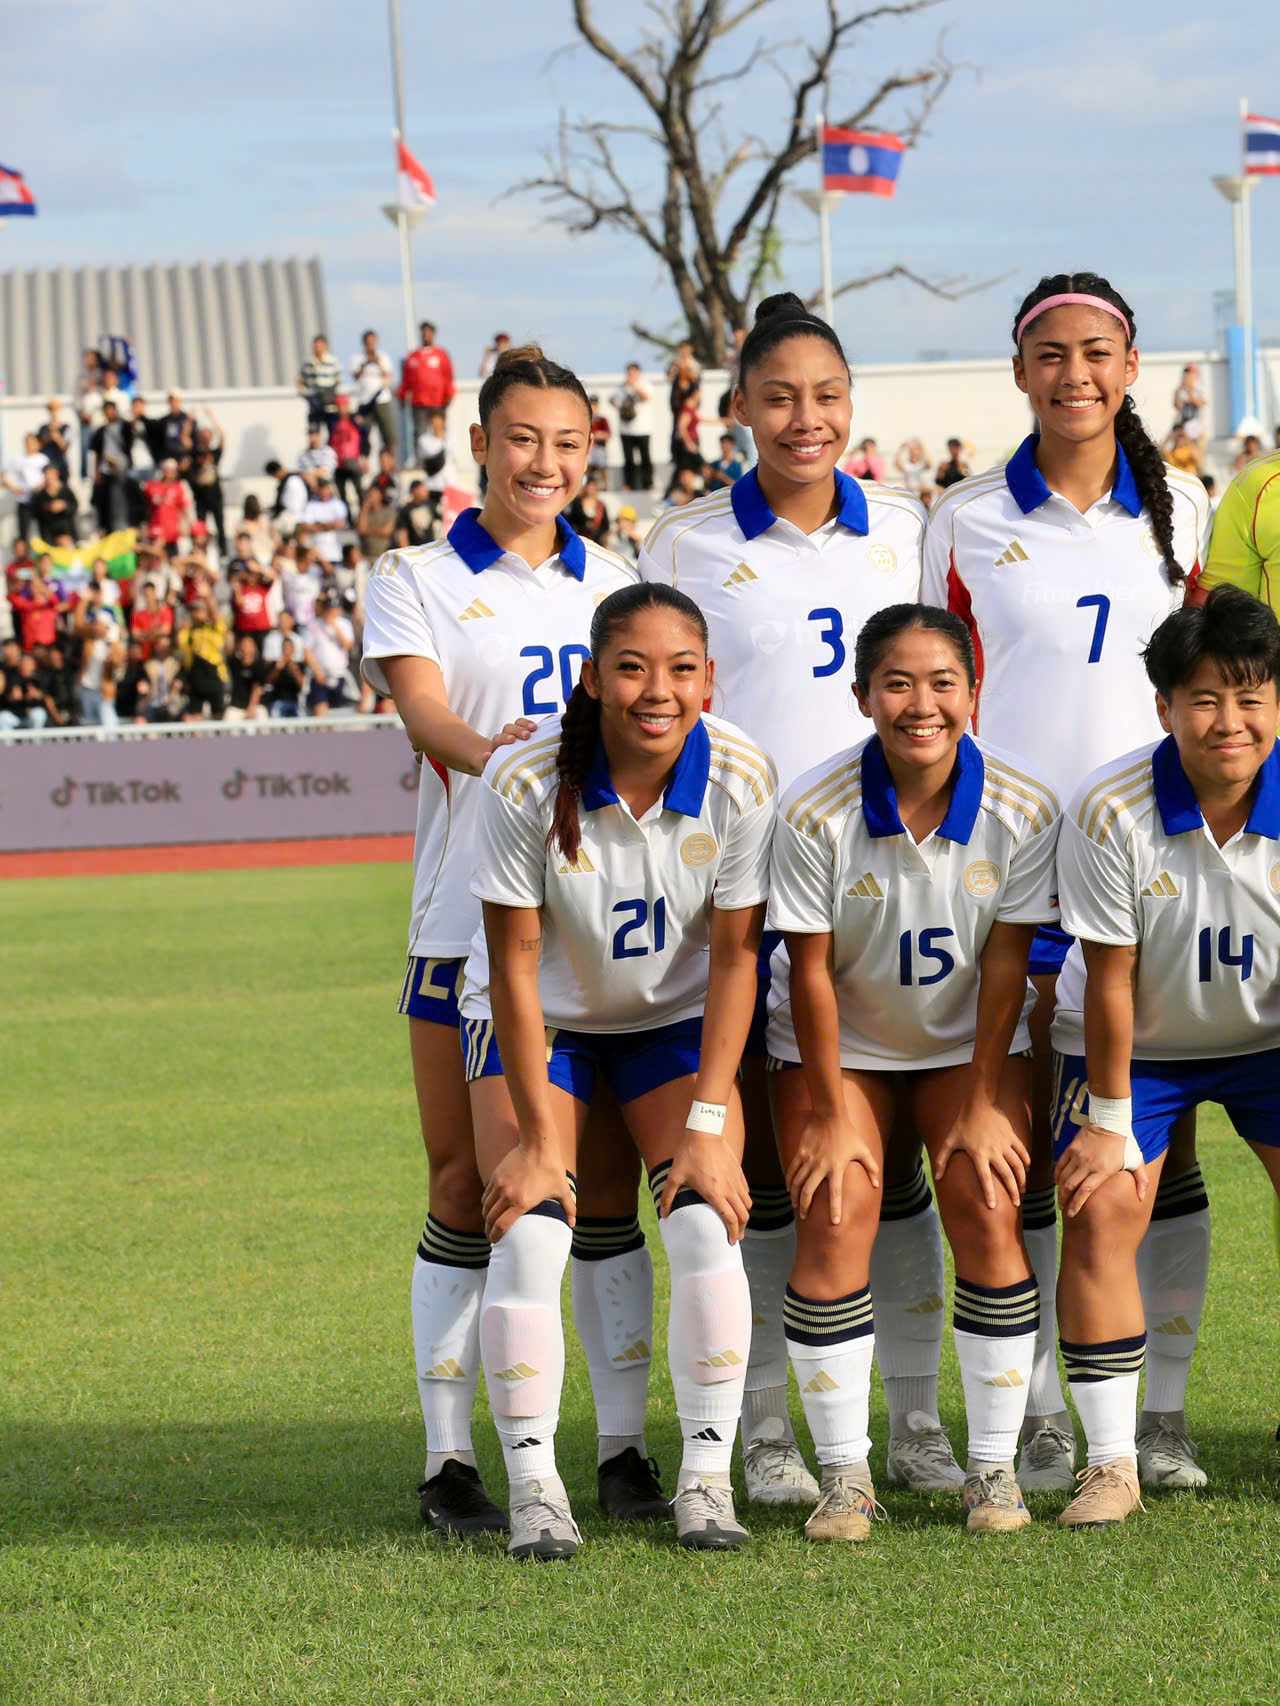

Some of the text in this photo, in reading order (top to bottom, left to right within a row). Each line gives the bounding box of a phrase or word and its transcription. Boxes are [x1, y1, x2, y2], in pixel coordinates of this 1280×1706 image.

[807, 607, 846, 678] 3
[1076, 594, 1111, 664] 7
[519, 643, 592, 716] 20
[82, 779, 182, 806] TikTok
[253, 771, 352, 799] TikTok
[612, 896, 666, 961] 21
[899, 926, 955, 987] 15
[1198, 925, 1254, 983] 14
